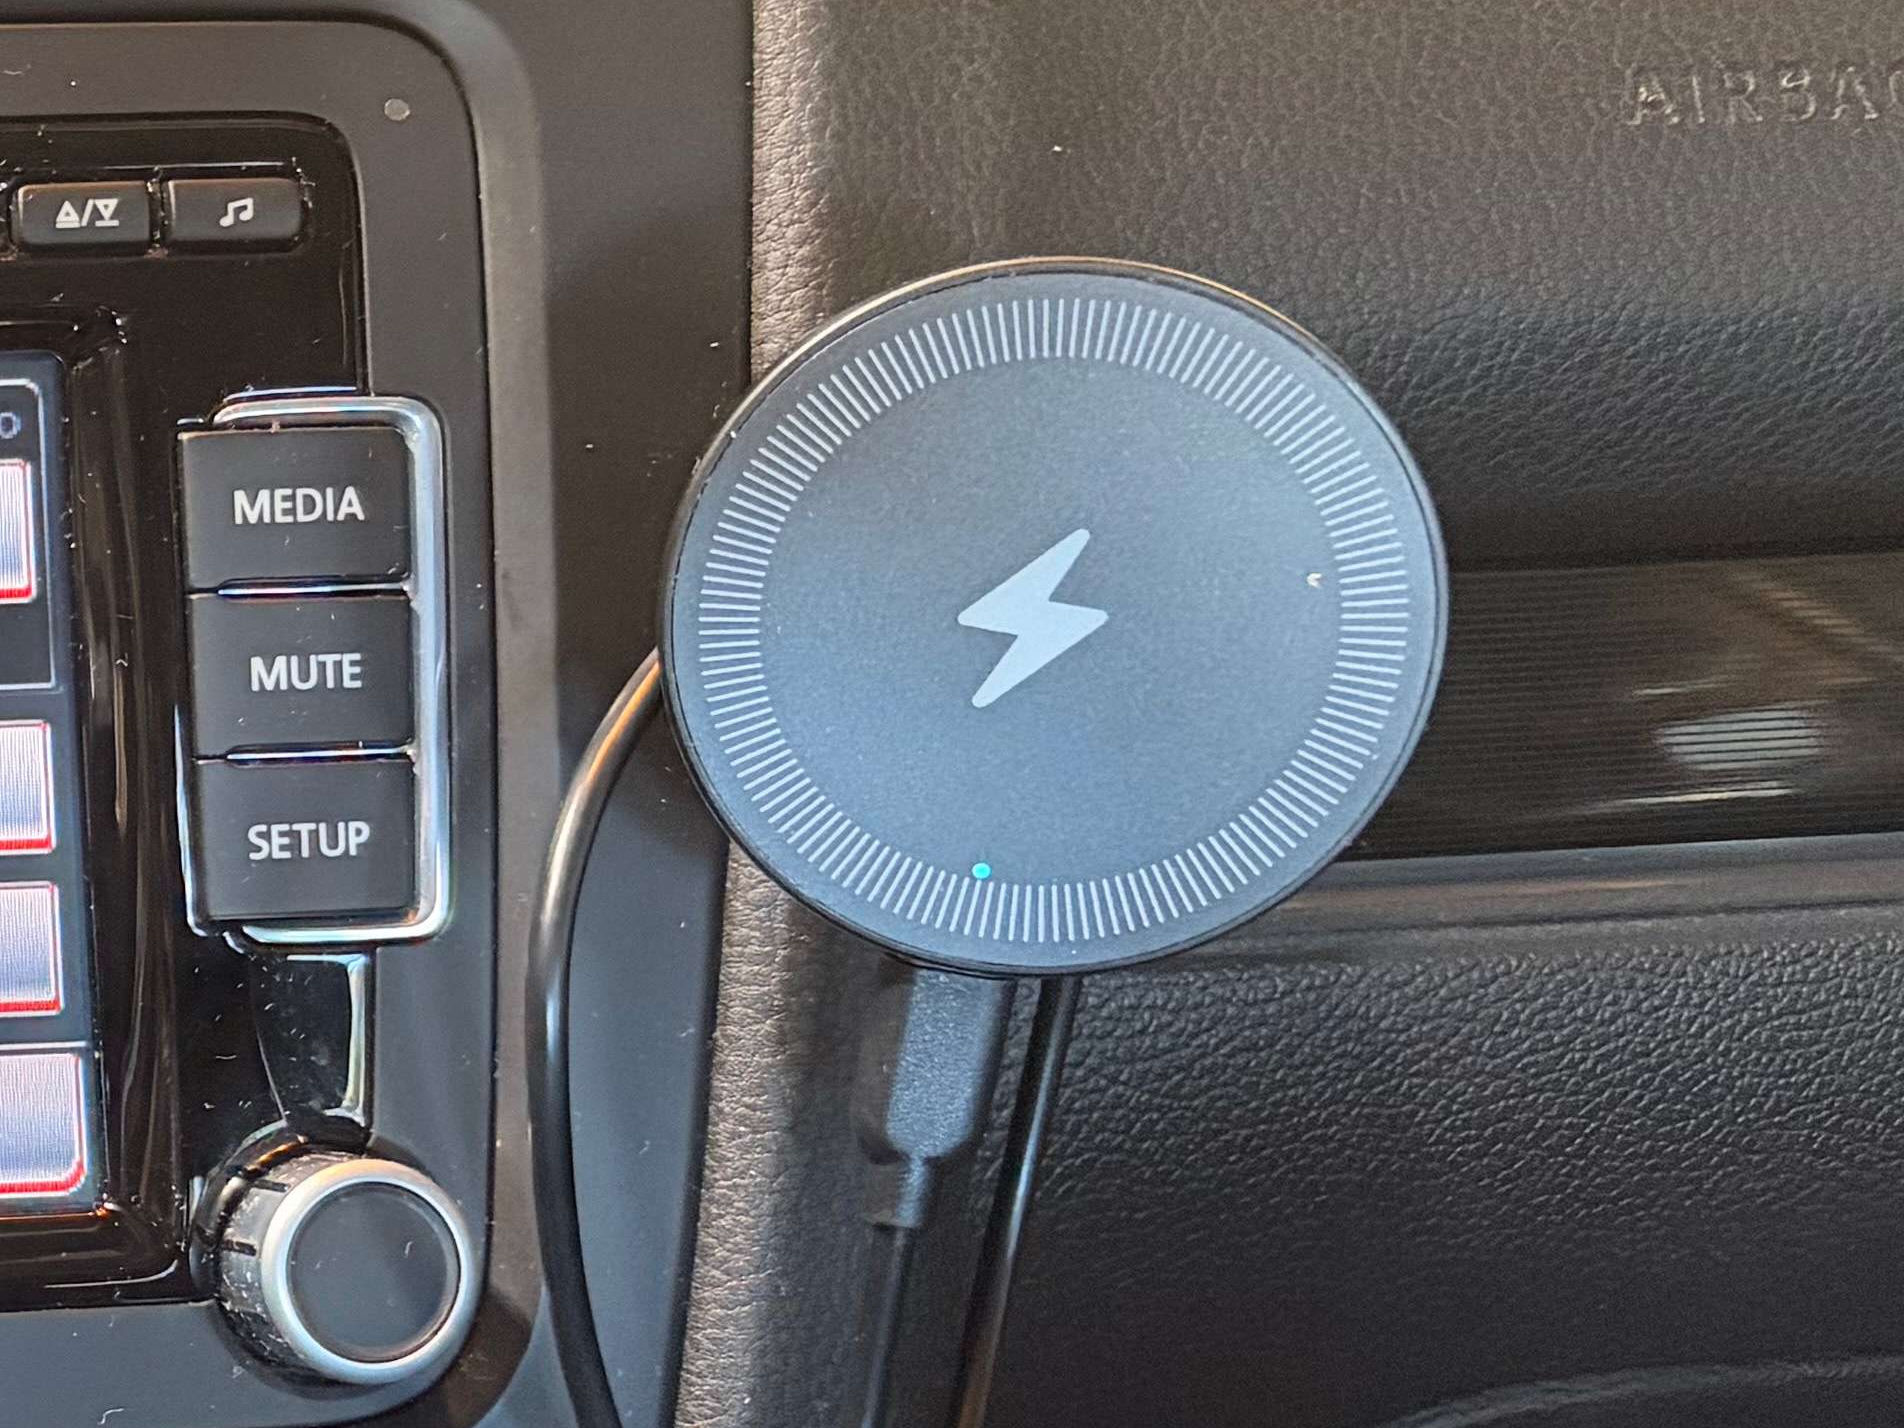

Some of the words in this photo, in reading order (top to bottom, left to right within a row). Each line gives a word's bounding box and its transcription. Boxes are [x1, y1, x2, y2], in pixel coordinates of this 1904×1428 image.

[233, 485, 365, 525] MEDIA
[249, 651, 363, 692] MUTE
[247, 820, 371, 861] SETUP
